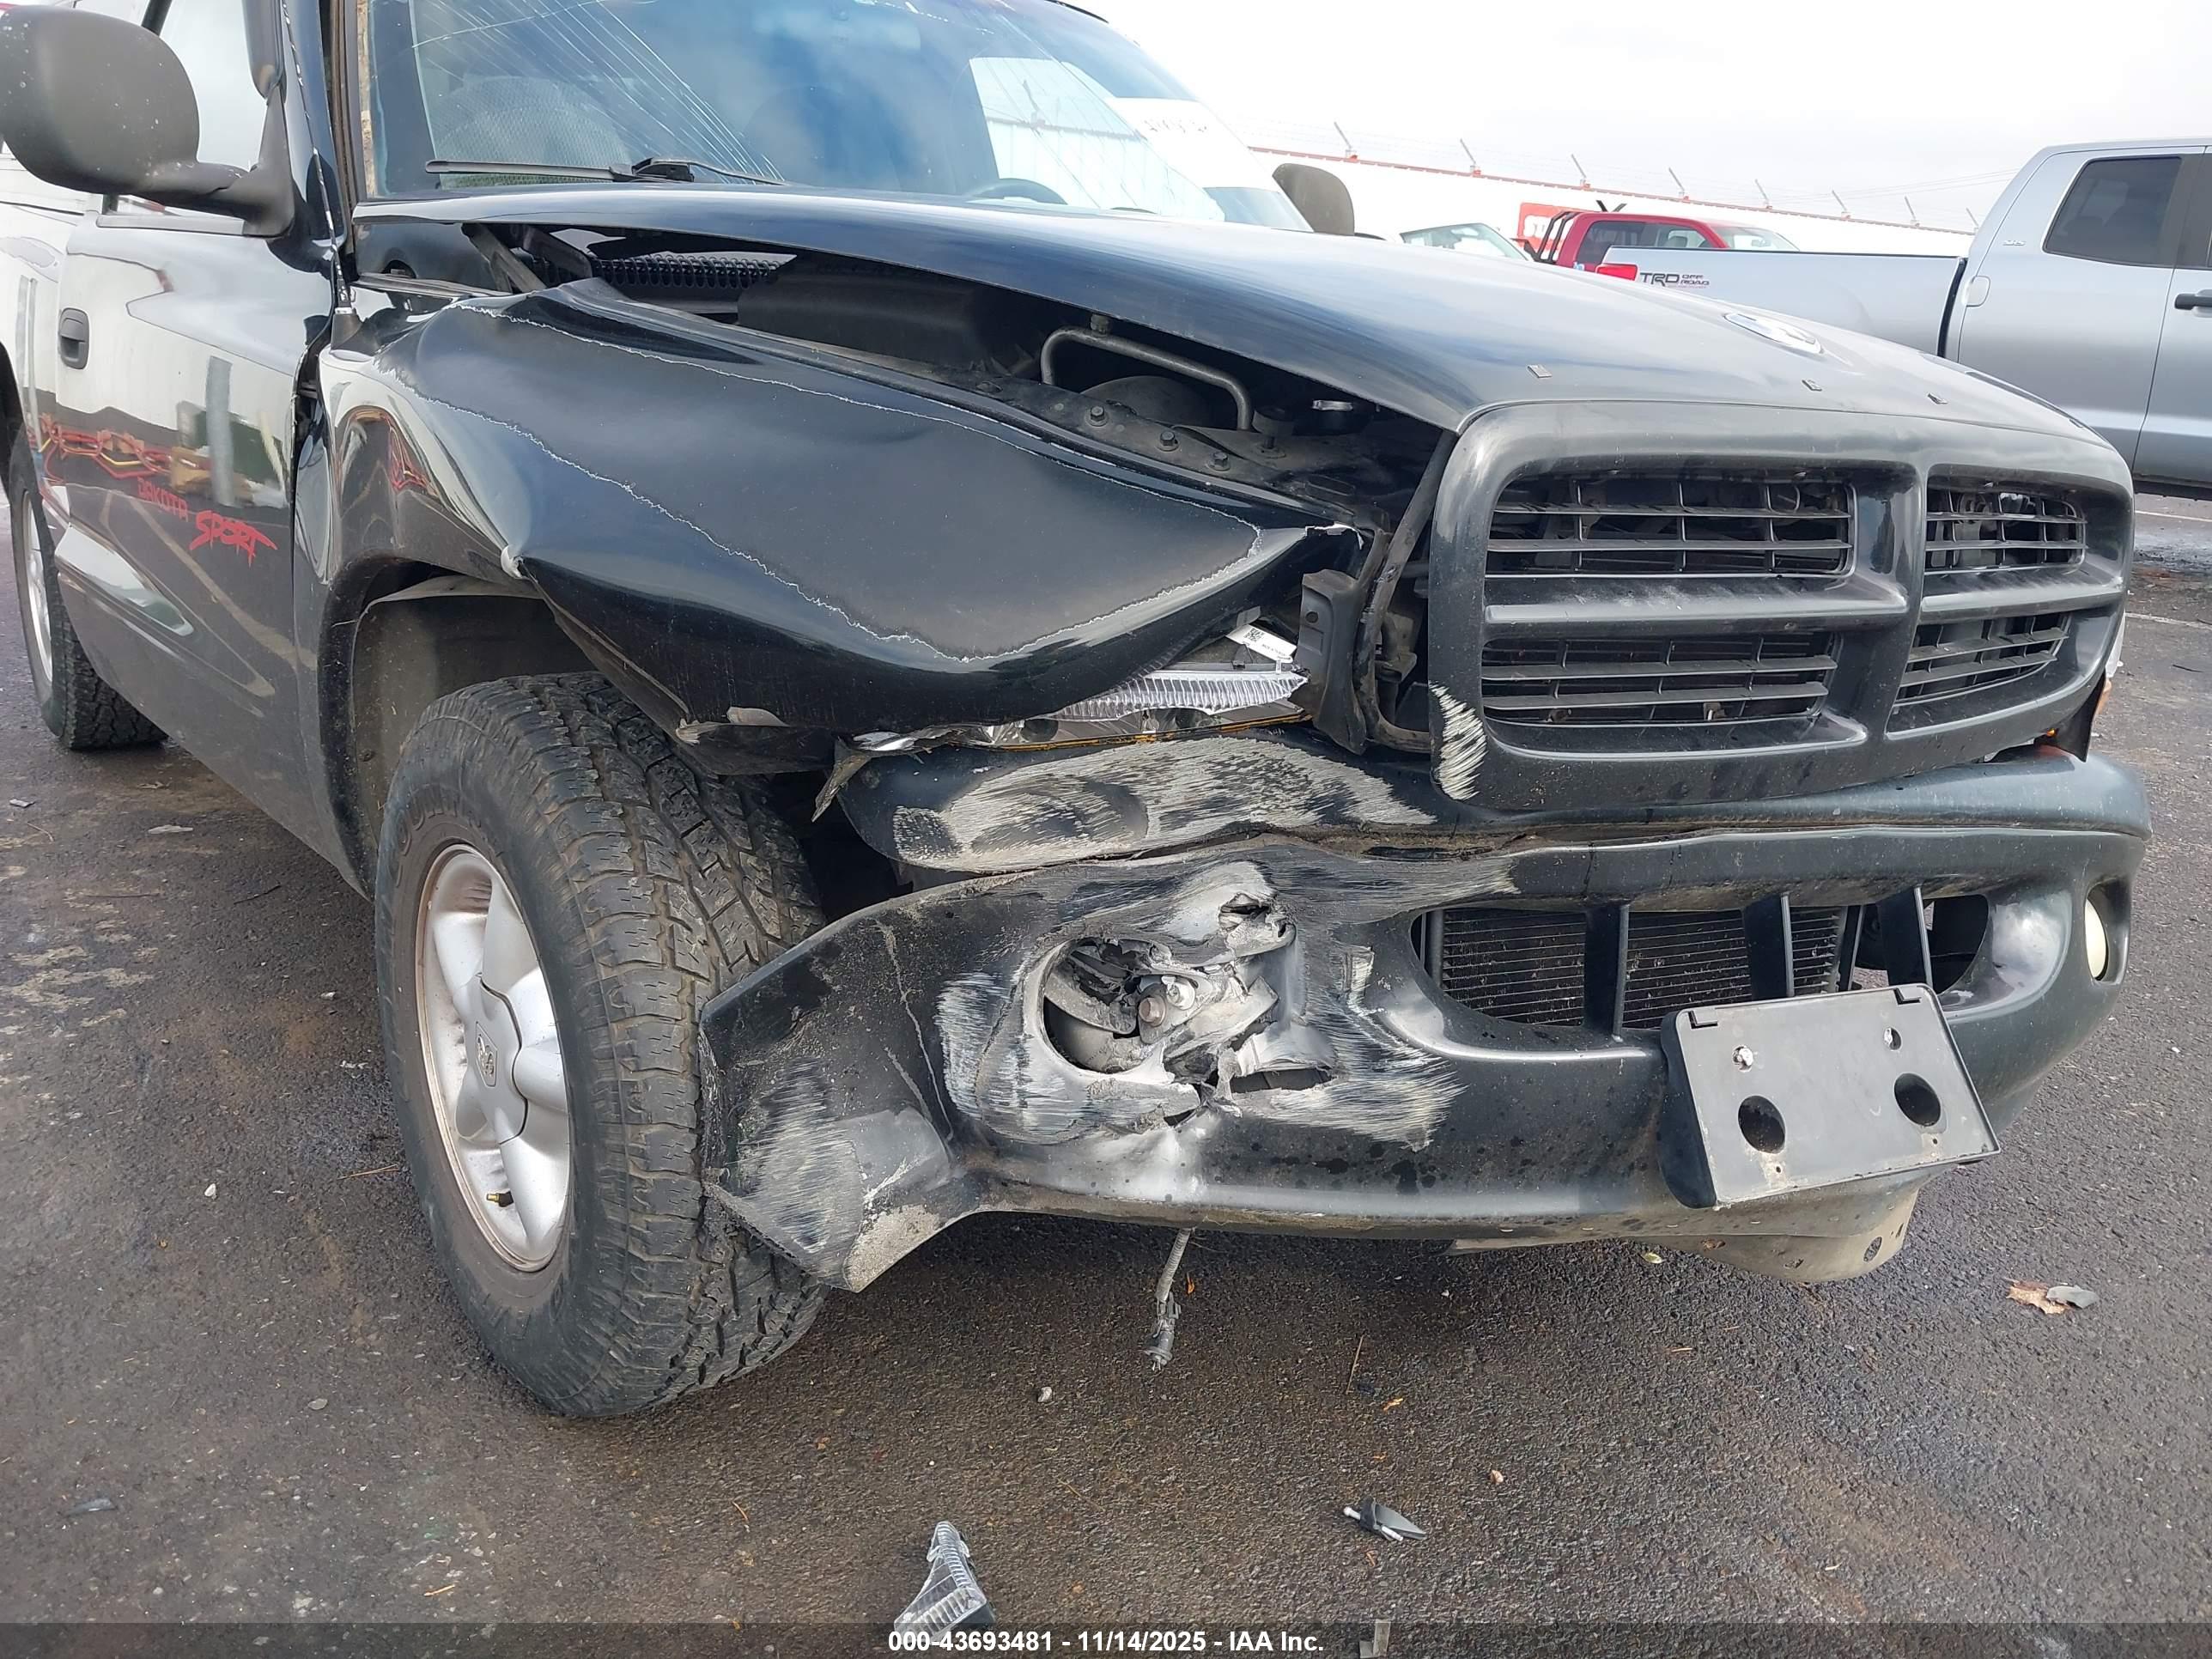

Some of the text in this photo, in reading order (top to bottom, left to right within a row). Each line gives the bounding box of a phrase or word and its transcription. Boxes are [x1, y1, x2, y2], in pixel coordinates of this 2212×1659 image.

[1640, 272, 1680, 287] TRD
[137, 477, 277, 568] DAKOTA SPORT
